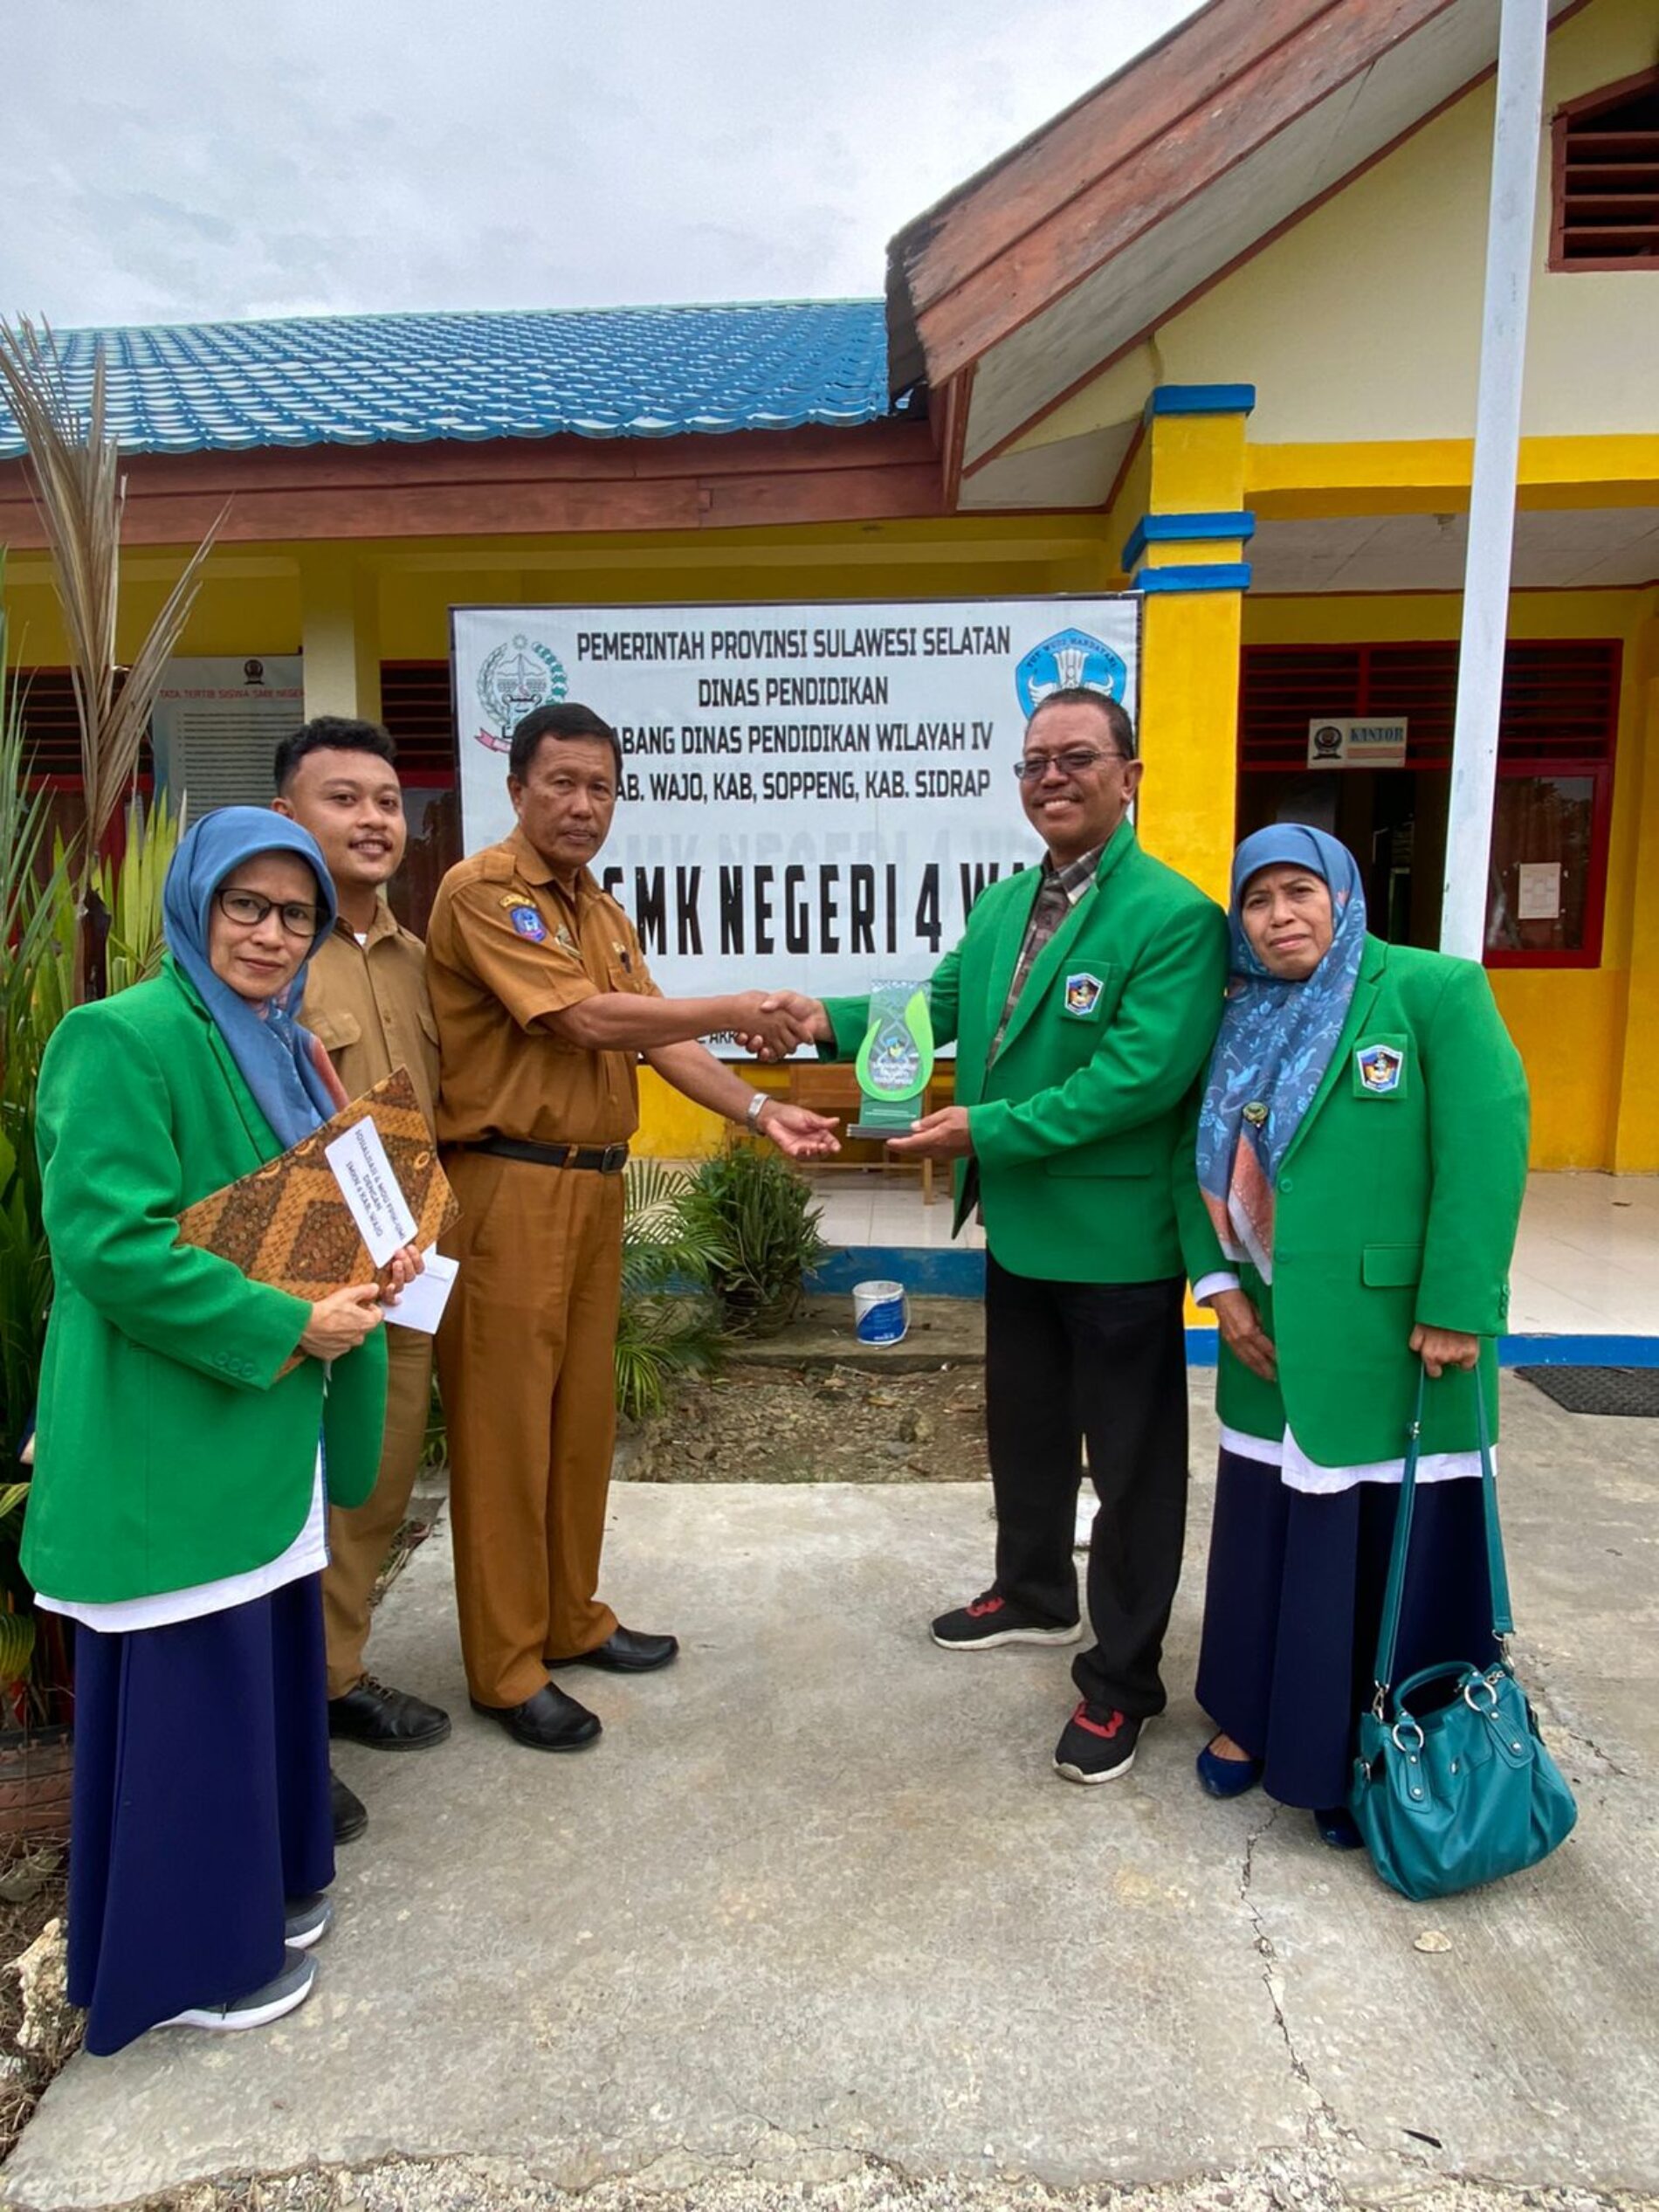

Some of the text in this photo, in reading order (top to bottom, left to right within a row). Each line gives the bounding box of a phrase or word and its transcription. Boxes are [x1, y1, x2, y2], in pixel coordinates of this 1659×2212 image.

[577, 625, 1010, 661] PEMERINTAH PROVINSI SULAWESI SELATAN
[699, 676, 888, 707] DINAS PENDIDIKAN
[616, 721, 994, 755] ABANG DINAS PENDIDIKAN WILAYAH IV
[1351, 727, 1404, 741] KANTOR
[615, 773, 644, 802] AB.
[649, 772, 708, 804] WAJO,
[762, 771, 859, 803] SOPPENG,
[865, 770, 909, 799] KAB.
[915, 769, 990, 798] SIDRAP
[719, 864, 897, 955] NEGERI
[915, 863, 942, 953] 4
[362, 1174, 383, 1212] DENGAN
